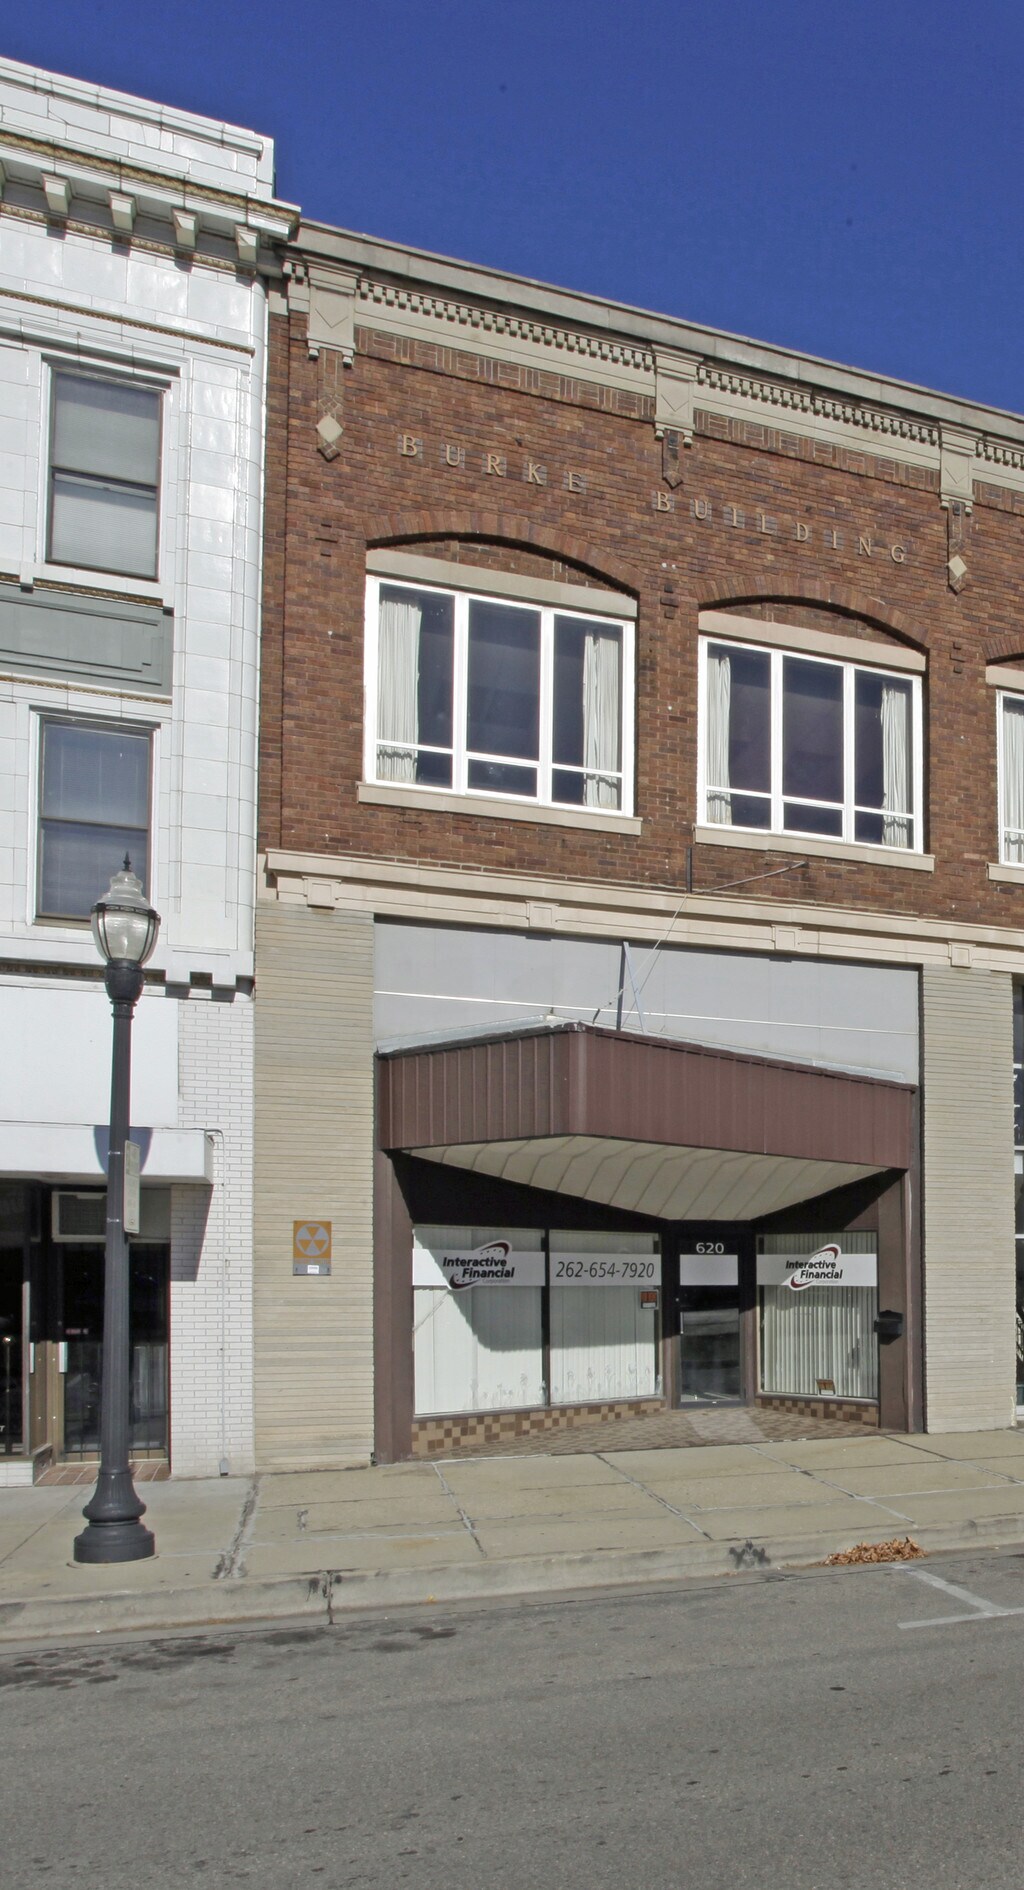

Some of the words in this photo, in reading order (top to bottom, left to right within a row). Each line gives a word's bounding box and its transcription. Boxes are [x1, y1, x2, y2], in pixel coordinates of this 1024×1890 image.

[400, 435, 583, 492] BURKE
[654, 490, 905, 563] BUILDING
[696, 1242, 725, 1254] 620
[443, 1257, 507, 1267] Interactive
[785, 1260, 836, 1269] Interactive
[462, 1267, 515, 1278] Financial
[556, 1261, 655, 1279] 262-654-7920
[800, 1269, 843, 1279] Financial
